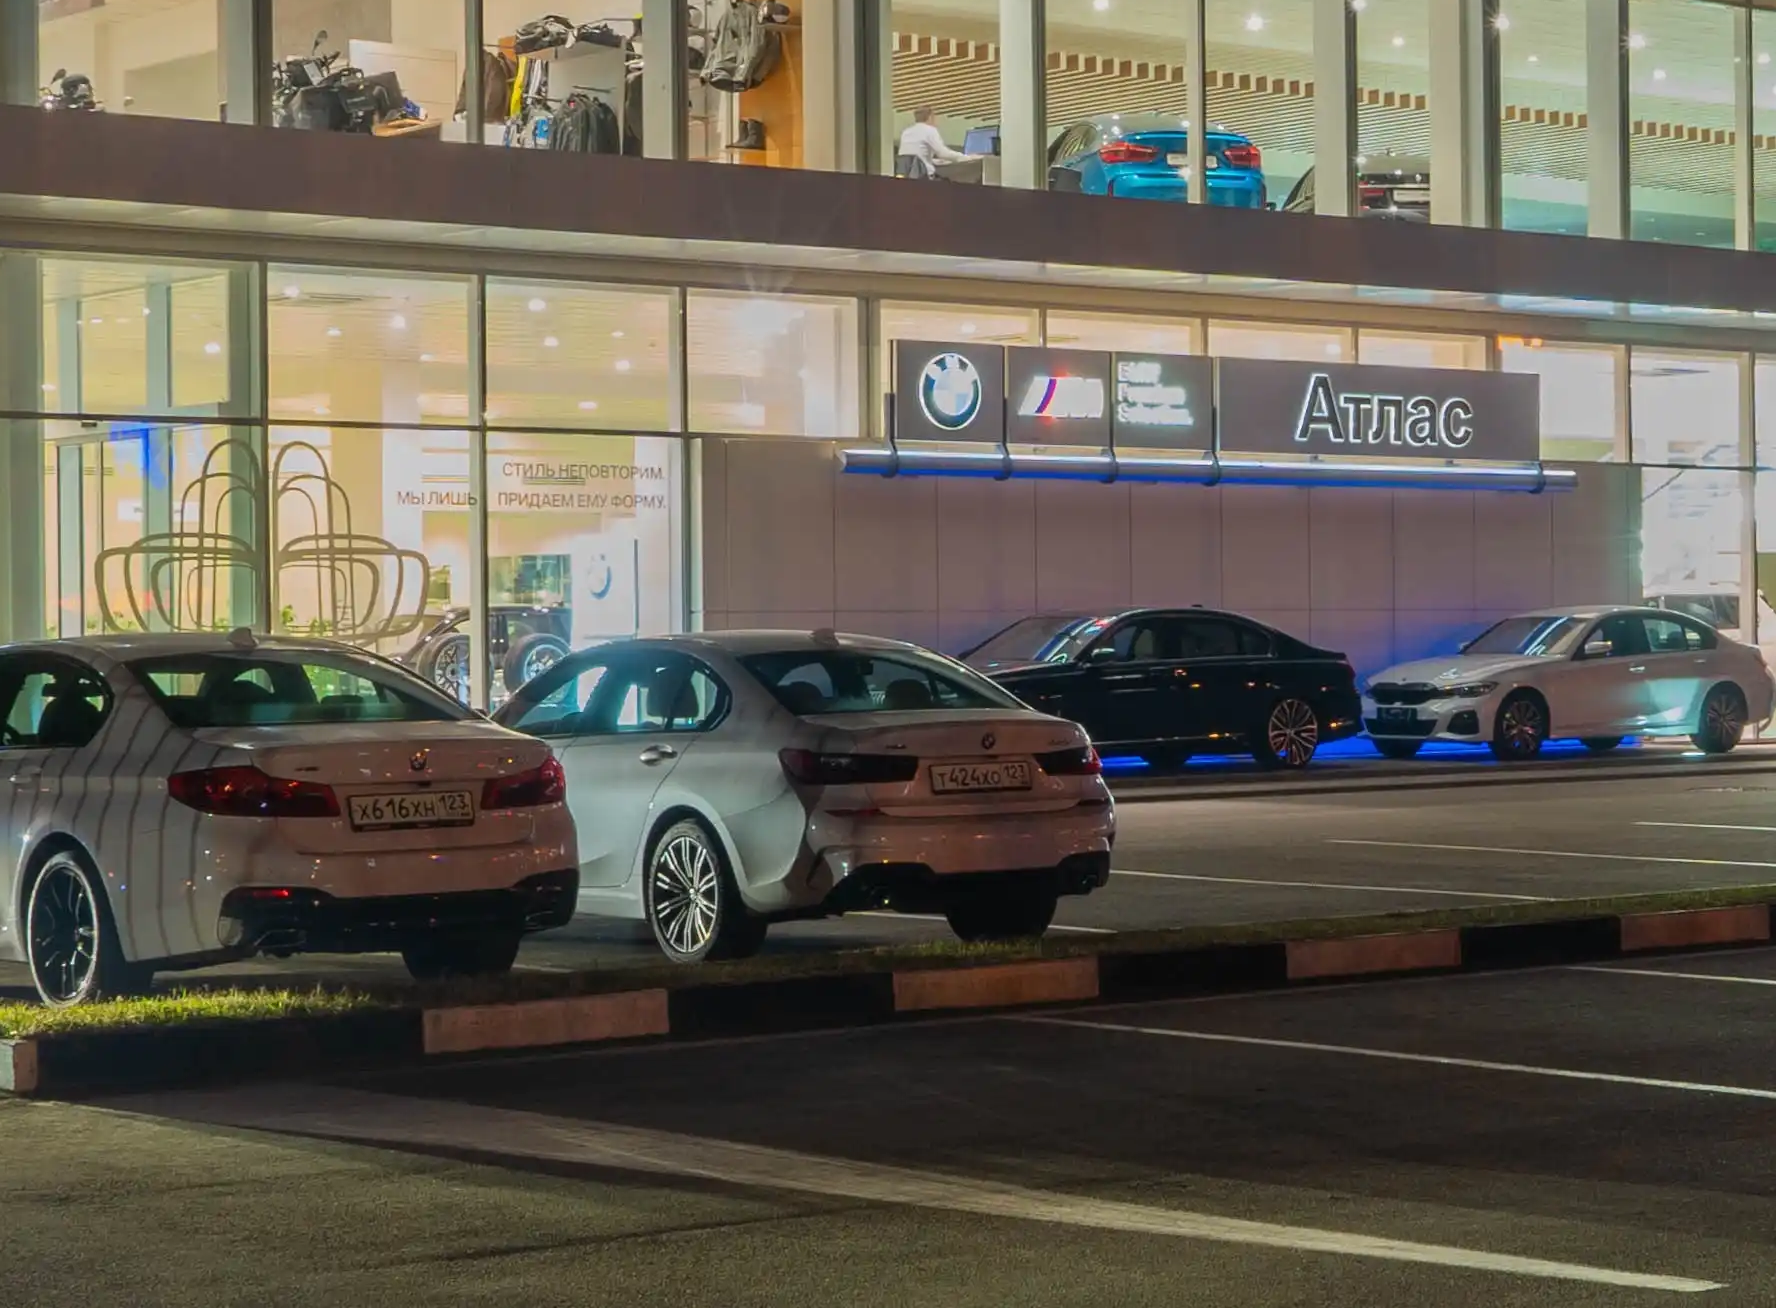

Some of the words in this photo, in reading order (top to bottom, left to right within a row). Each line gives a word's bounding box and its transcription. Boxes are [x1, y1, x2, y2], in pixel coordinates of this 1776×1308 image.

[1296, 373, 1473, 447] Атлас
[502, 463, 557, 479] СТИЛЬ
[559, 465, 665, 480] НЕПОВТОРИМ.
[397, 491, 424, 505] МЫ
[427, 491, 478, 507] ЛИШЬ
[498, 494, 574, 509] ПРИДАЕМ
[611, 493, 666, 510] ФОРМУ.
